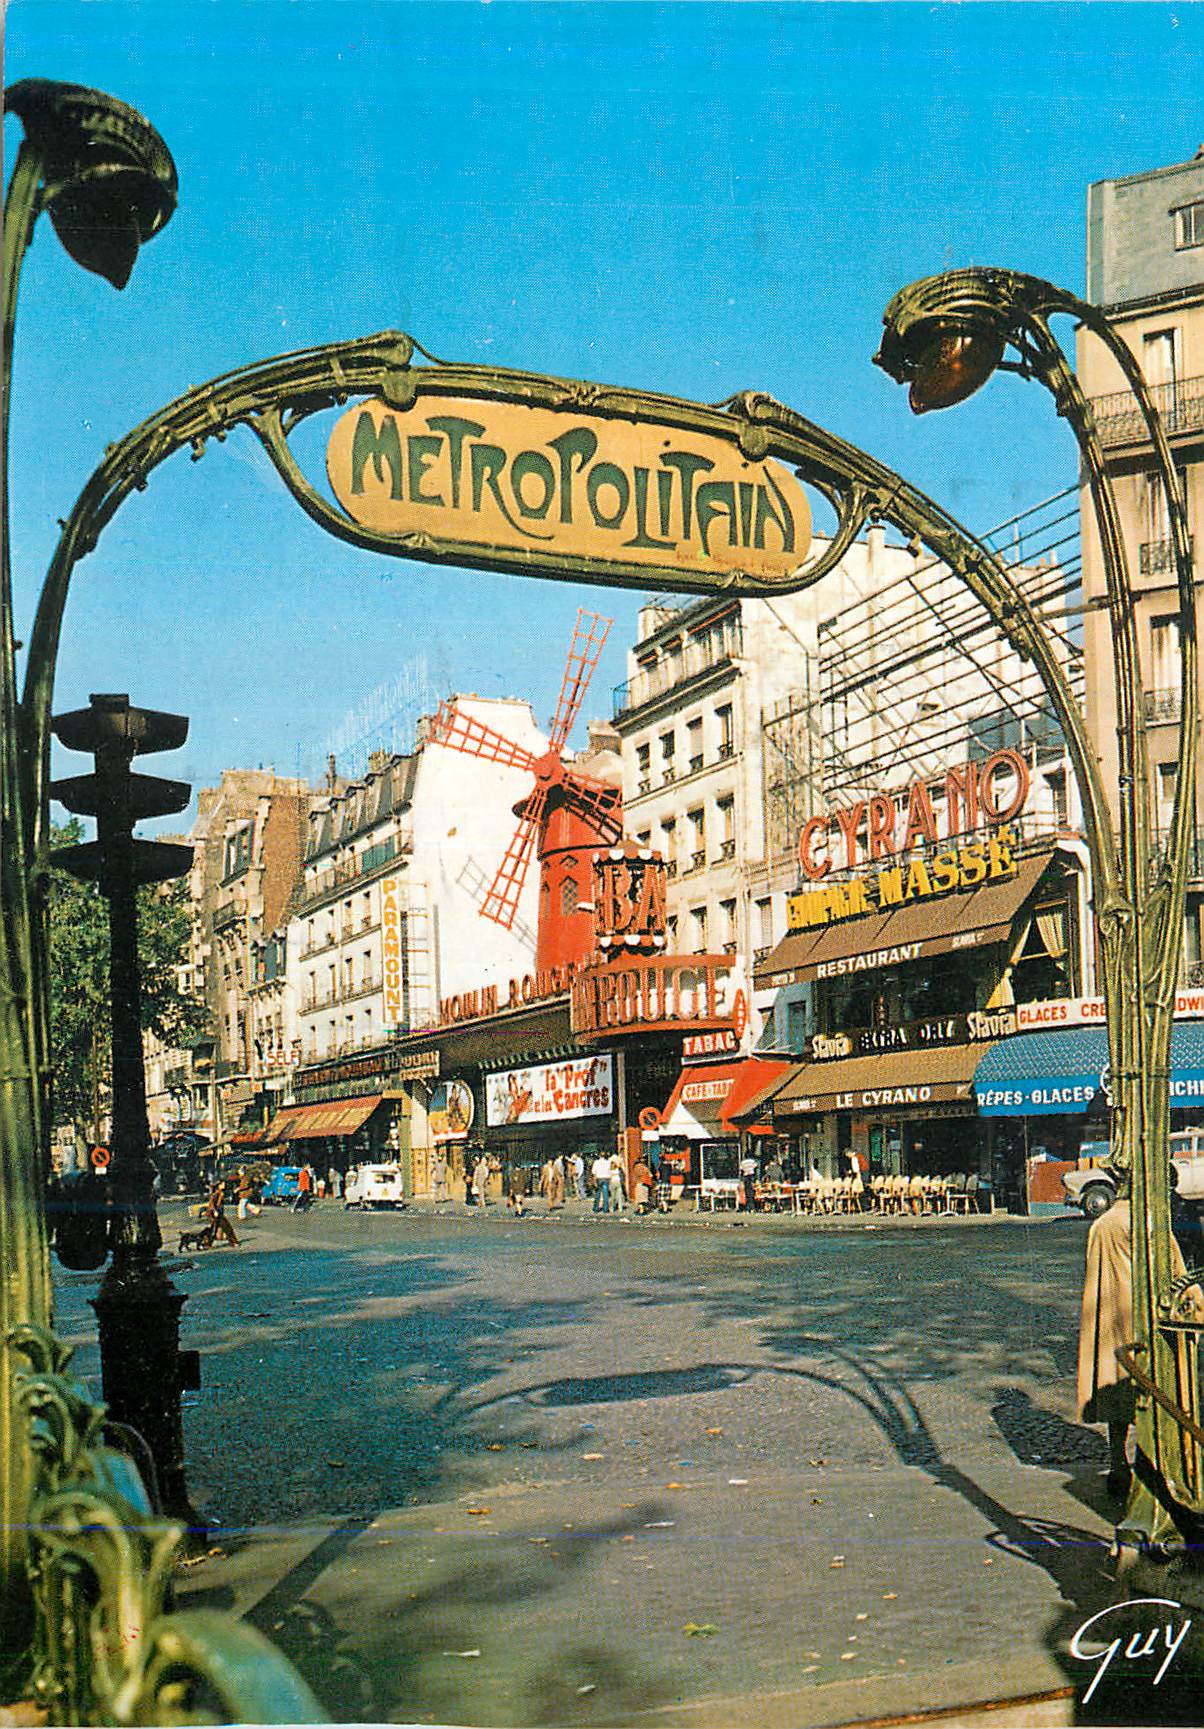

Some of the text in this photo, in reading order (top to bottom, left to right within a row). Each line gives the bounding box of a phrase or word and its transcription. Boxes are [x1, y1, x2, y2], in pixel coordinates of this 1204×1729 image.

[350, 410, 796, 555] METROPOLITAIN
[800, 750, 1029, 879] CYRANO
[383, 879, 400, 1021] PARAMOUNT
[817, 943, 922, 978] RESTAURANT
[440, 984, 498, 1025] MOULIN
[599, 966, 732, 1027] ROUGE
[1019, 1006, 1067, 1024] GLACES
[267, 1050, 299, 1066] SELF
[683, 1031, 735, 1055] TABAC
[836, 1087, 931, 1108] LE CYRANO
